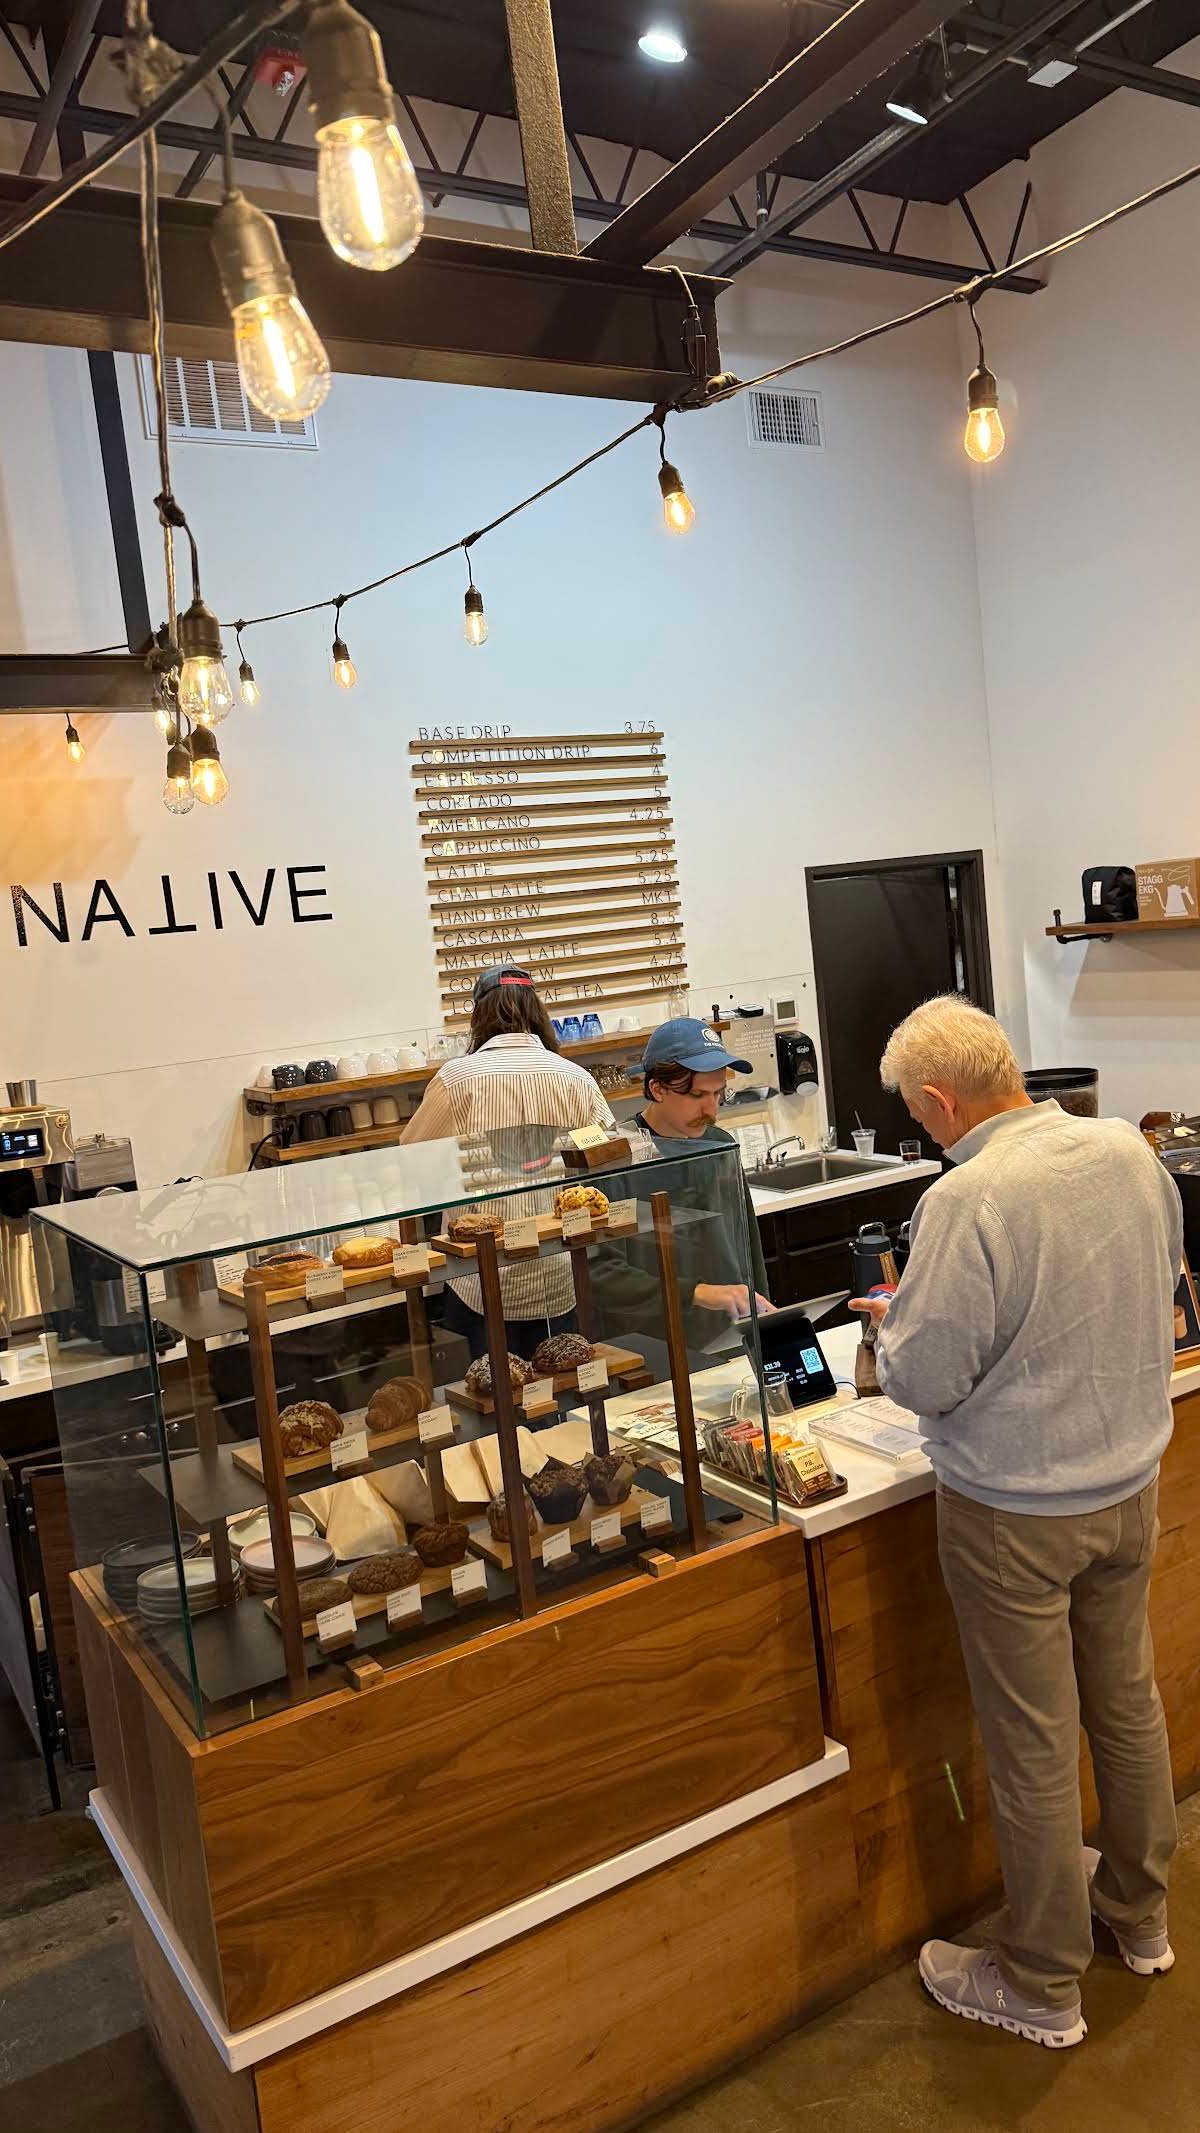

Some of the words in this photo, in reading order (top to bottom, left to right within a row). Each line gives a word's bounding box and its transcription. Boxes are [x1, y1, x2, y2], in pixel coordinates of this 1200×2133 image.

[418, 726, 465, 741] BASE
[471, 724, 511, 739] DRIP
[624, 720, 656, 734] 3.75
[421, 746, 546, 765] COMPETITION
[552, 744, 591, 760] DRIP
[650, 742, 658, 755] 6
[652, 764, 661, 776] 4
[424, 770, 520, 788] ESPRESSO
[654, 785, 662, 798] 5
[426, 793, 512, 811] CORTADO
[629, 807, 664, 821] 4.25
[429, 814, 531, 834] AMERICANO
[659, 828, 667, 840] 5
[431, 836, 541, 857] CAPPUCCINO
[635, 848, 669, 863] 5.25
[436, 862, 494, 879] LATTE
[638, 869, 672, 884] 5.25
[1137, 874, 1163, 886] STAGG
[437, 886, 479, 903] CHAI
[490, 880, 546, 899] LATTE
[641, 890, 673, 905] MKT
[1138, 884, 1154, 895] EKG
[440, 907, 487, 926] HAND
[493, 903, 541, 921] BREW
[443, 927, 524, 949] CASCARA
[444, 951, 515, 971] MATCHA
[529, 942, 582, 962] LATTE
[650, 952, 683, 967] 4.75
[651, 972, 681, 988] MKT
[574, 983, 604, 999] TEA
